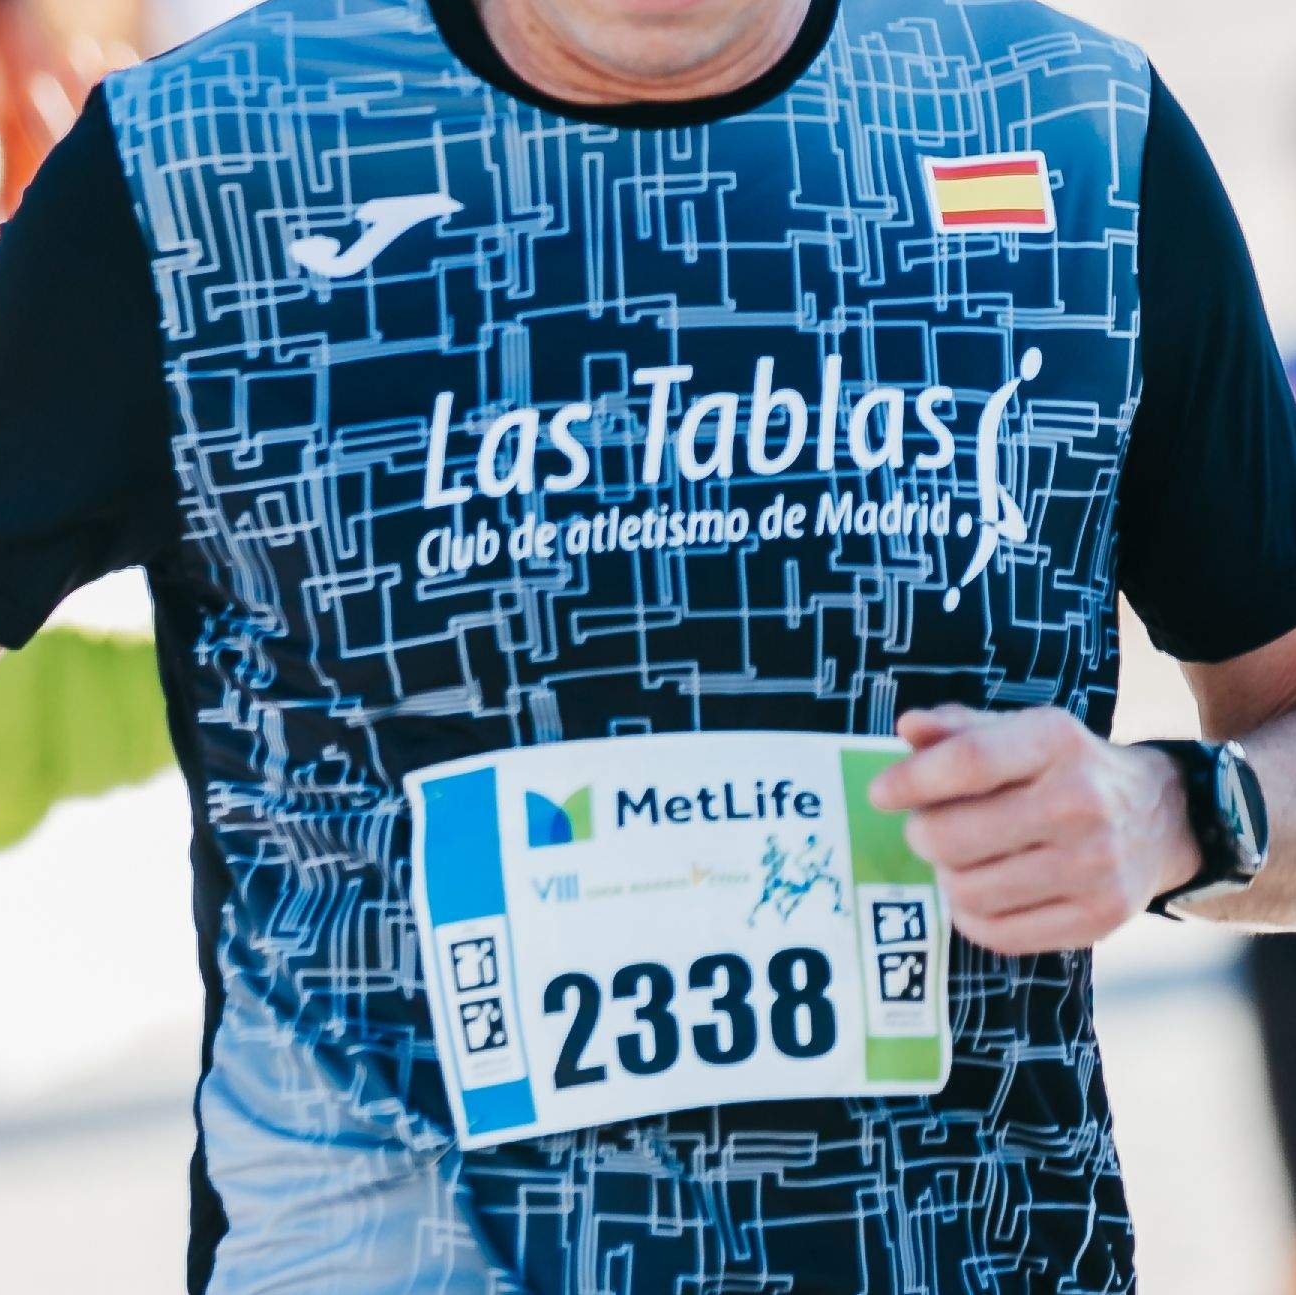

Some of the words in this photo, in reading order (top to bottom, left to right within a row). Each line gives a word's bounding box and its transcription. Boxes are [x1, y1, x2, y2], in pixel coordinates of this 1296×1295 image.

[422, 390, 592, 509] Las
[631, 354, 955, 483] Tablas
[417, 518, 499, 577] Club
[508, 511, 555, 559] de
[566, 503, 749, 554] atletismo
[758, 493, 806, 539] de
[815, 489, 950, 538] Madrid
[616, 779, 822, 829] MetLife
[531, 871, 579, 903] VIII
[543, 947, 836, 1091] 2338
